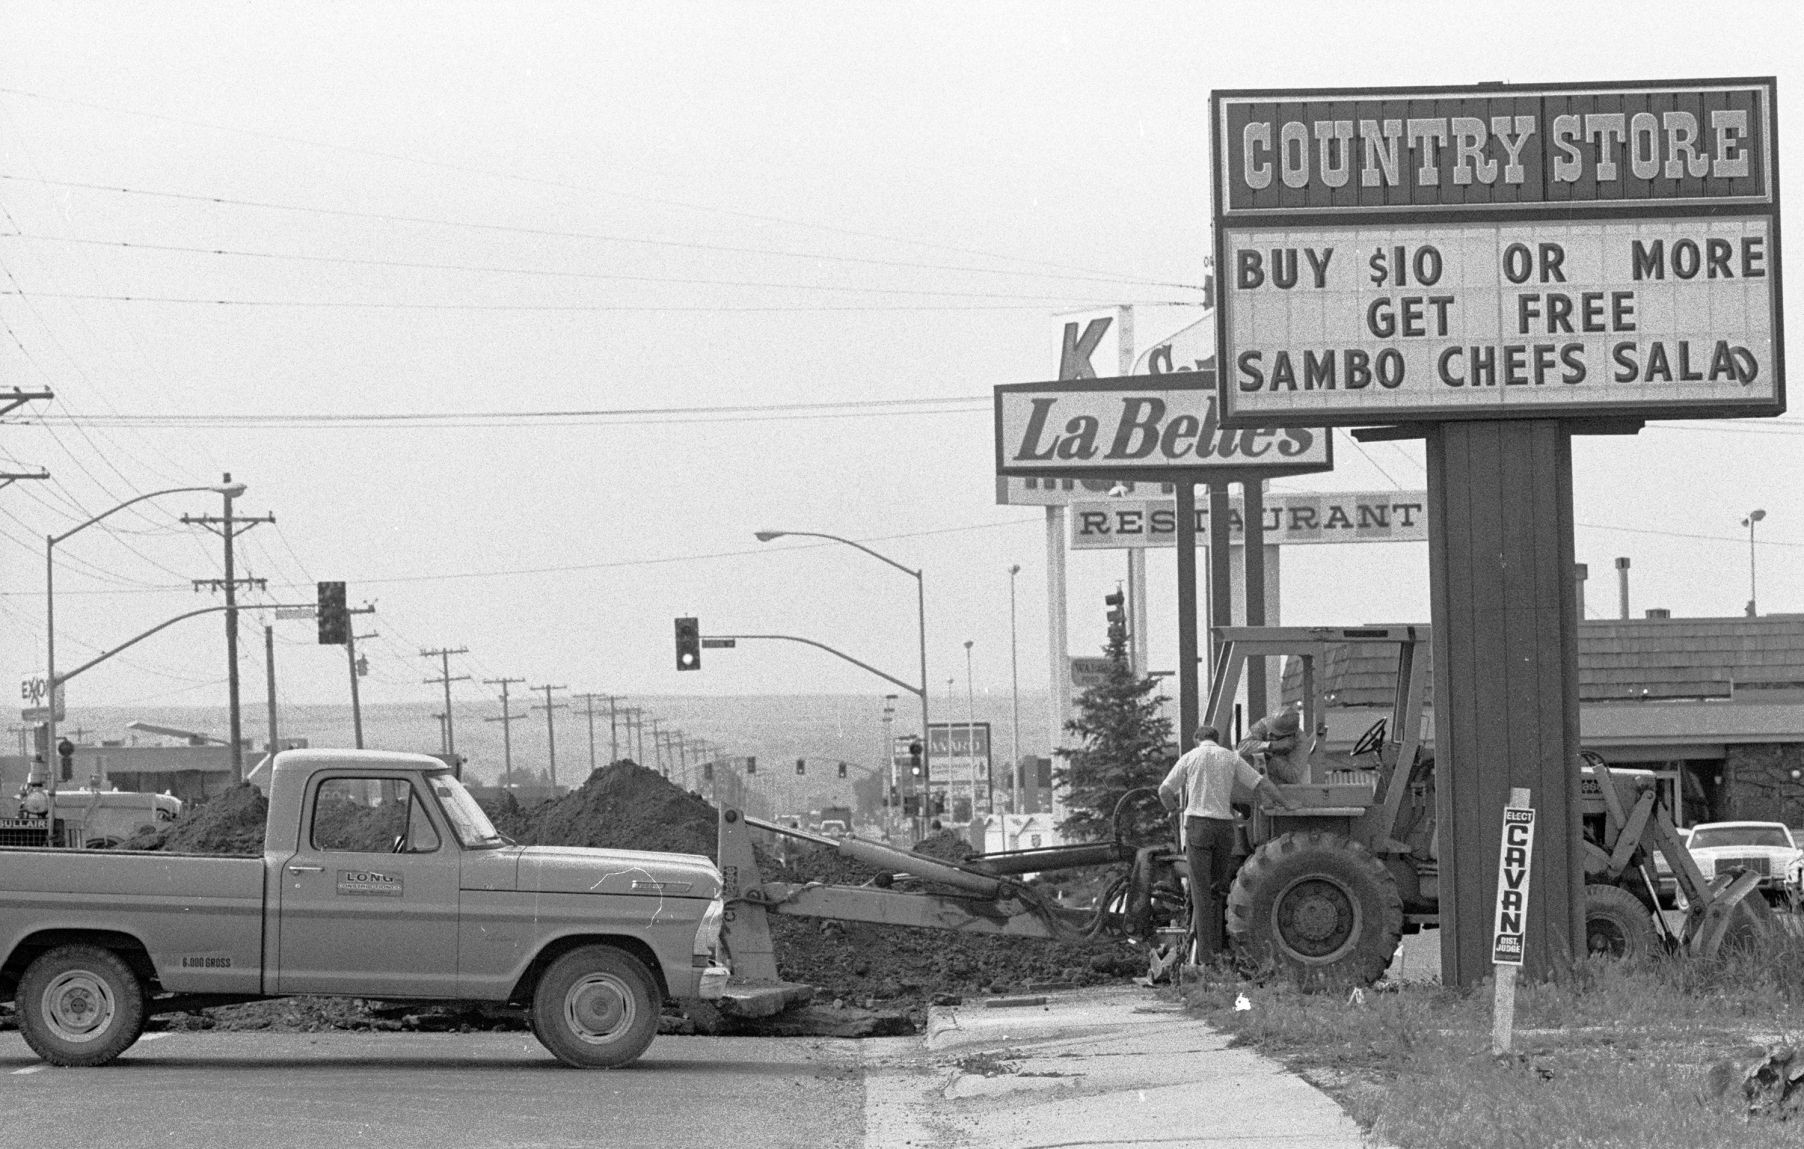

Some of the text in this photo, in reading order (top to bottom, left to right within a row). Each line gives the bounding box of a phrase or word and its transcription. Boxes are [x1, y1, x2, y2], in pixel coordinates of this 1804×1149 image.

[1243, 109, 1750, 190] COUNTRY STORE
[1236, 236, 1766, 290] BUY $10 OR MORE
[1366, 290, 1637, 338] GET FREE
[1237, 347, 1406, 393] SAMBO
[1437, 342, 1588, 388] CHEFS
[1612, 340, 1759, 388] SALAD
[1012, 397, 1099, 461] La
[1079, 503, 1422, 535] RESTAURANT
[1506, 811, 1533, 822] ELECT
[346, 872, 394, 883] LONG
[1500, 824, 1529, 934] CAVAN
[205, 957, 231, 969] GROSS
[1495, 943, 1521, 954] JUDGE
